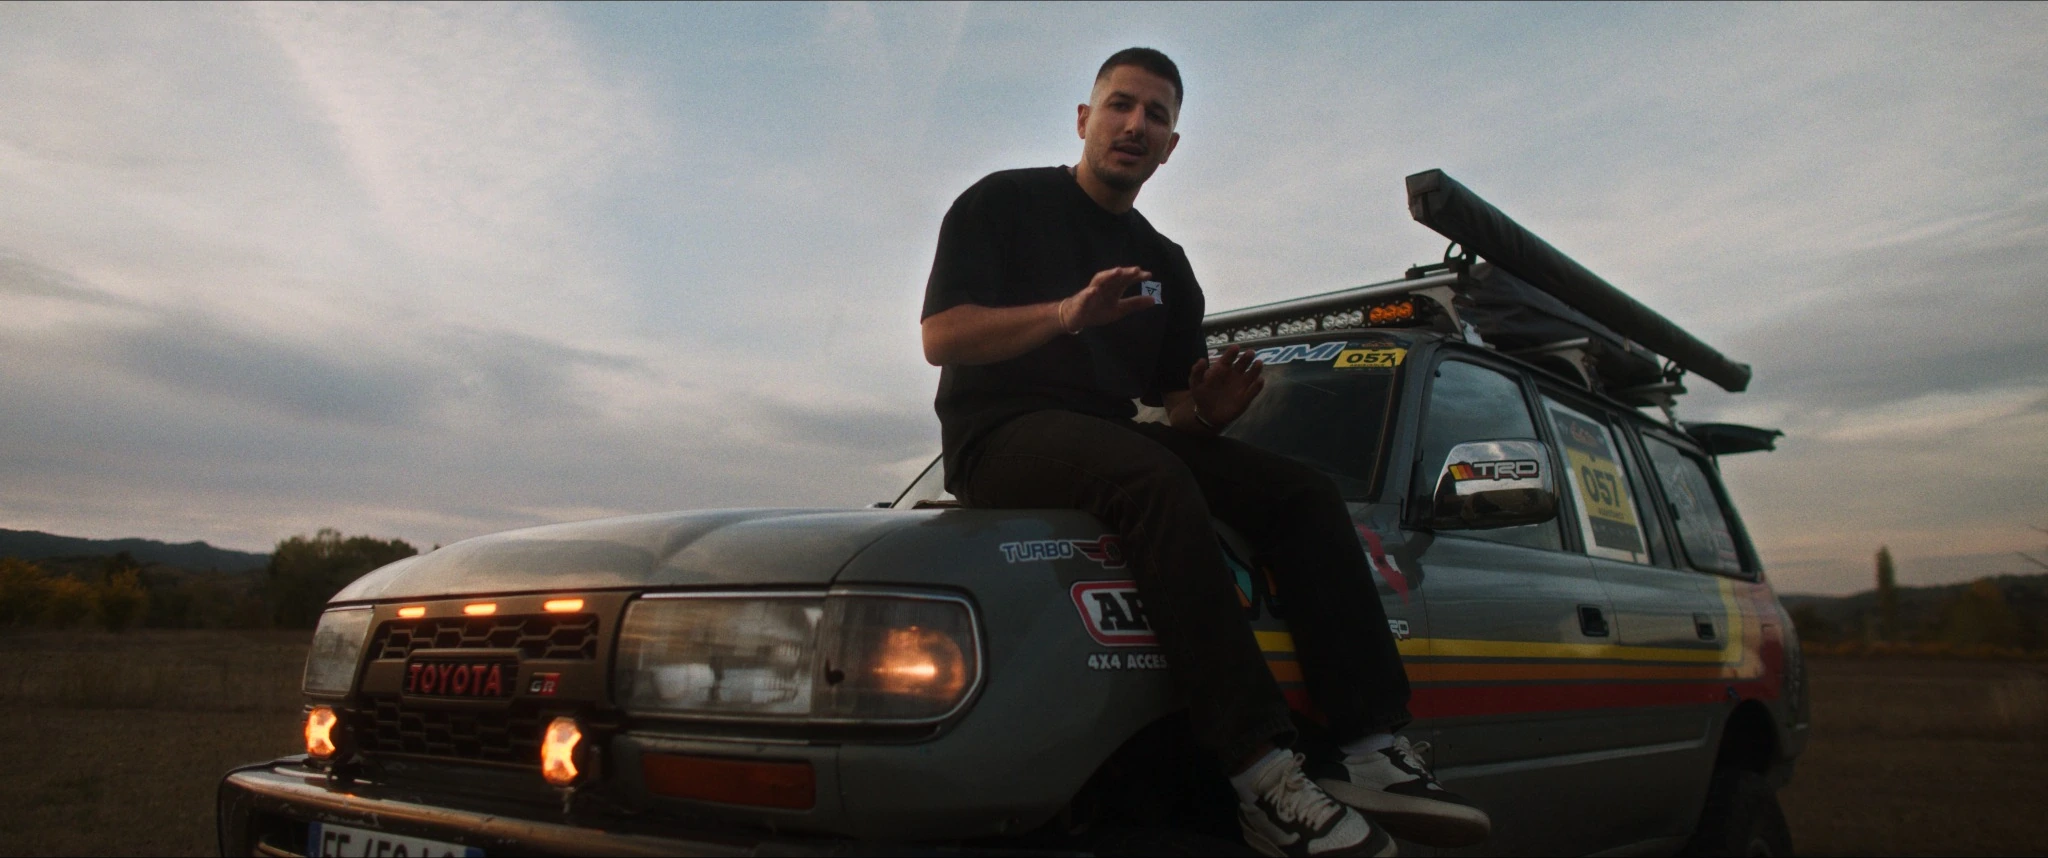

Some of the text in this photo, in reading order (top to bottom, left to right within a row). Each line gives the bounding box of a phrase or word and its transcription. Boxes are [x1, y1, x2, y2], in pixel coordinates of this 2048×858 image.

[1244, 341, 1348, 367] CIMI
[1345, 353, 1396, 364] 057
[1473, 461, 1534, 480] TRD
[1580, 466, 1620, 507] 057
[1000, 540, 1073, 562] TURBO
[1126, 653, 1168, 669] ACCES
[409, 663, 503, 697] TOYOTA
[530, 678, 556, 693] GR
